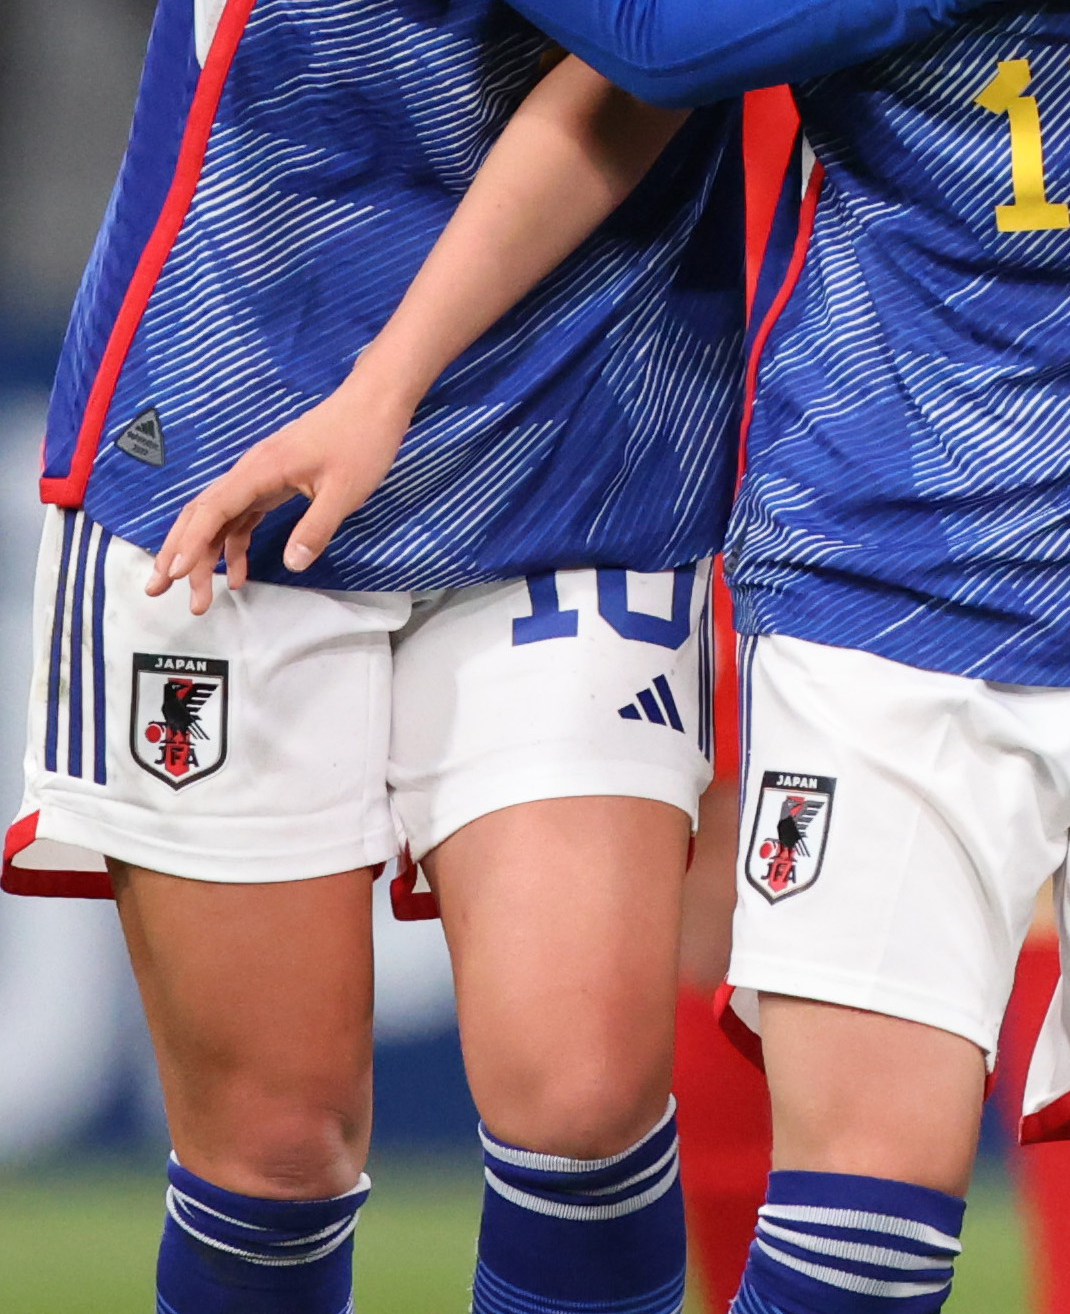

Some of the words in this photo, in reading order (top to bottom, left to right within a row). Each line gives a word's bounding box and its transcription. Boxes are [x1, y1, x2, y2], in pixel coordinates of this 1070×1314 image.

[154, 657, 208, 672] JAPAN
[154, 746, 200, 768] JFA
[776, 774, 818, 789] JAPAN
[760, 861, 797, 884] JFA
